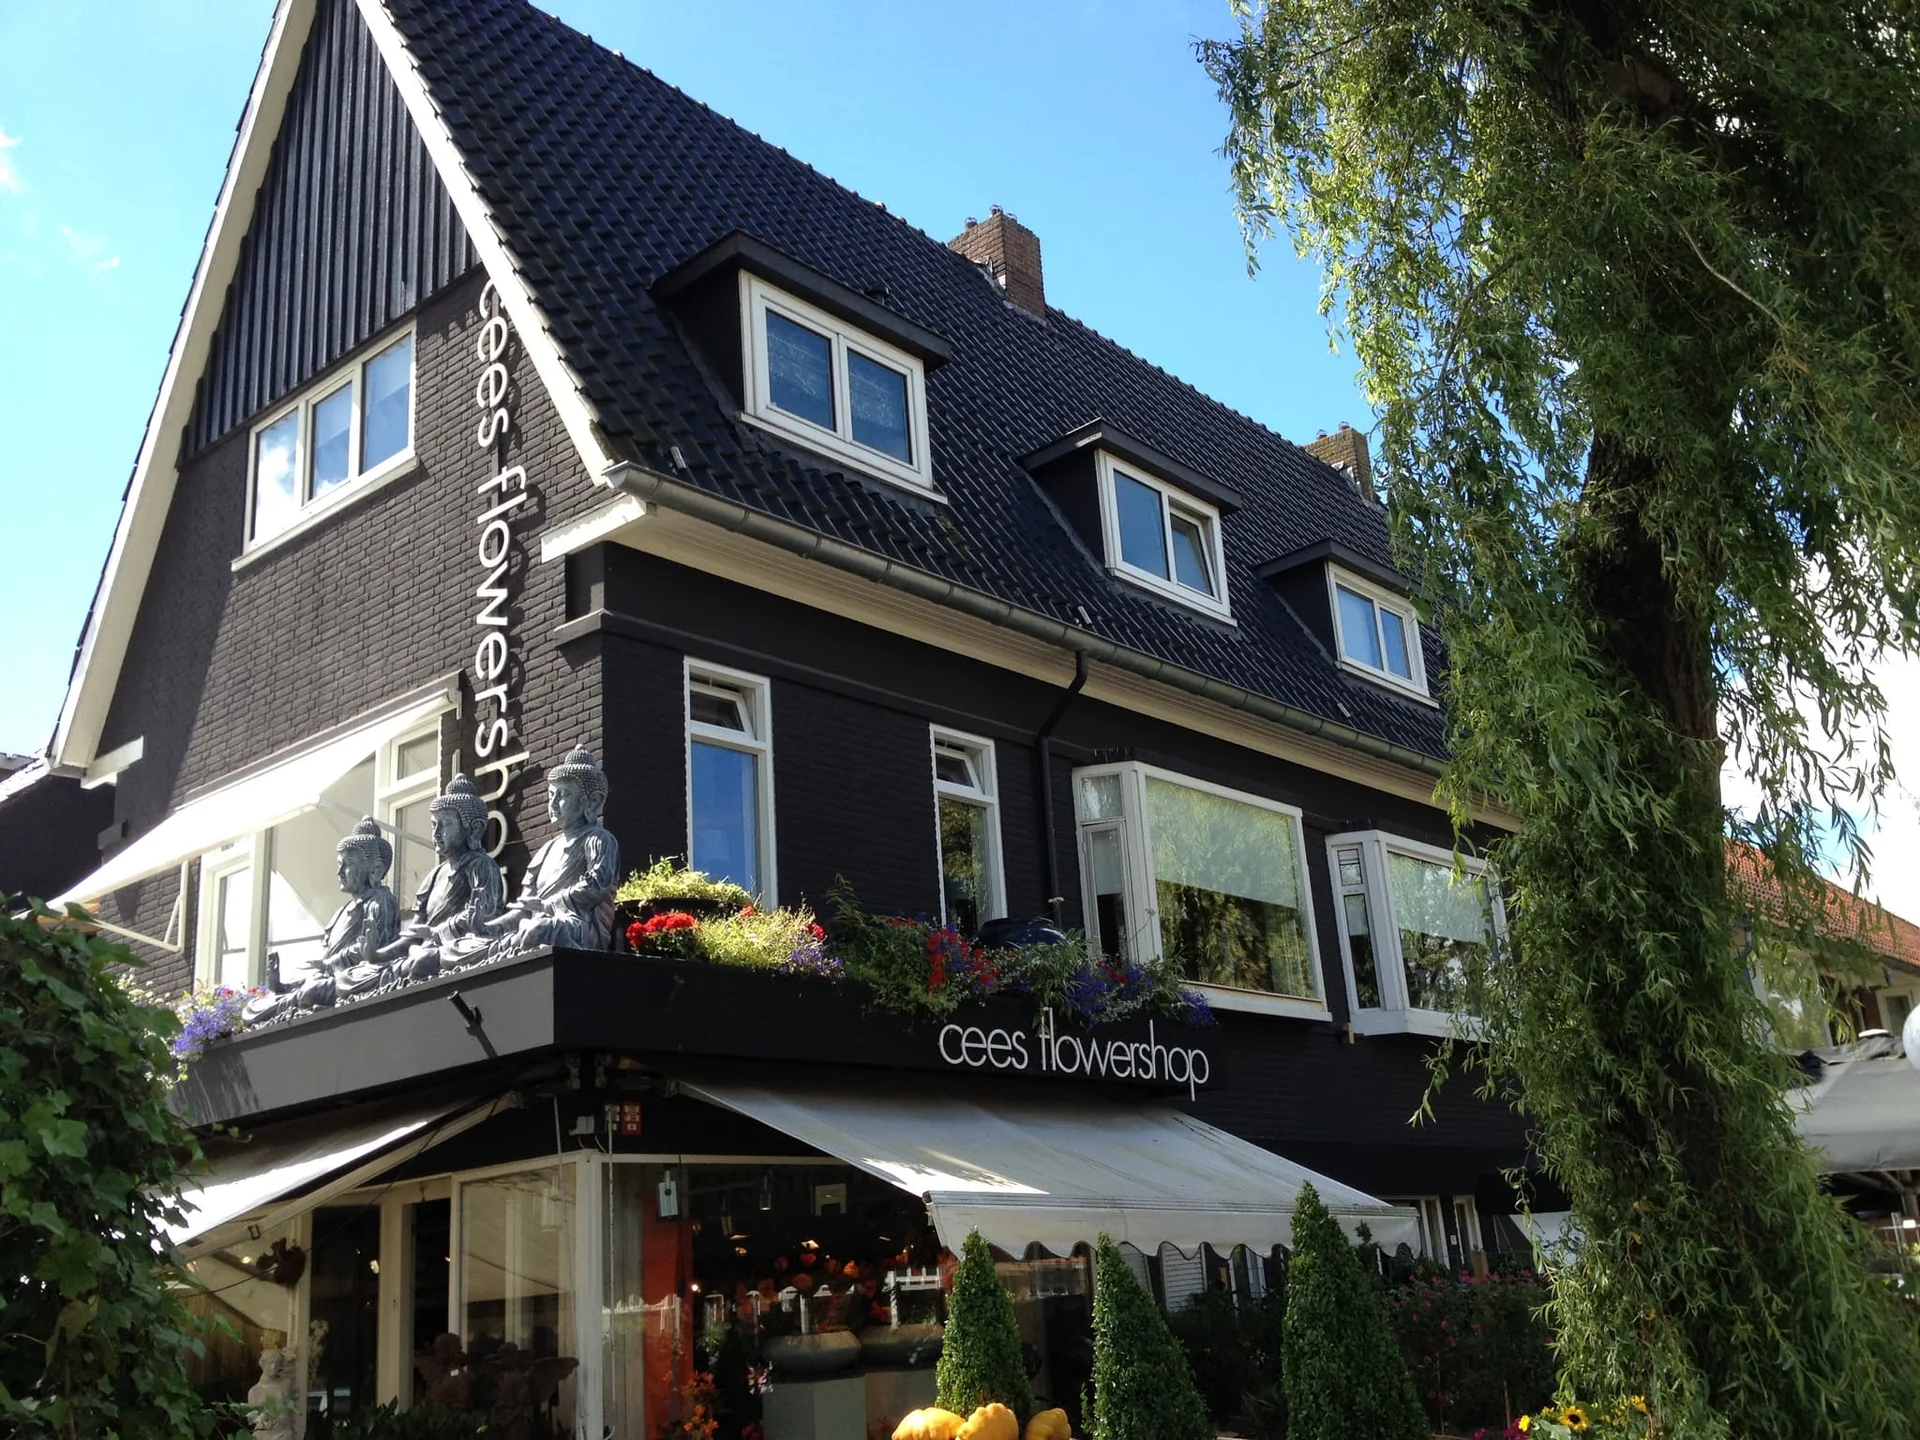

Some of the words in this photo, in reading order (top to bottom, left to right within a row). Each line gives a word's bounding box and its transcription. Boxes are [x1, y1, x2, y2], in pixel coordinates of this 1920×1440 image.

[477, 278, 509, 447] cees
[476, 465, 530, 904] flowersho
[939, 1024, 1028, 1070] cees
[1039, 1006, 1209, 1102] flowershop
